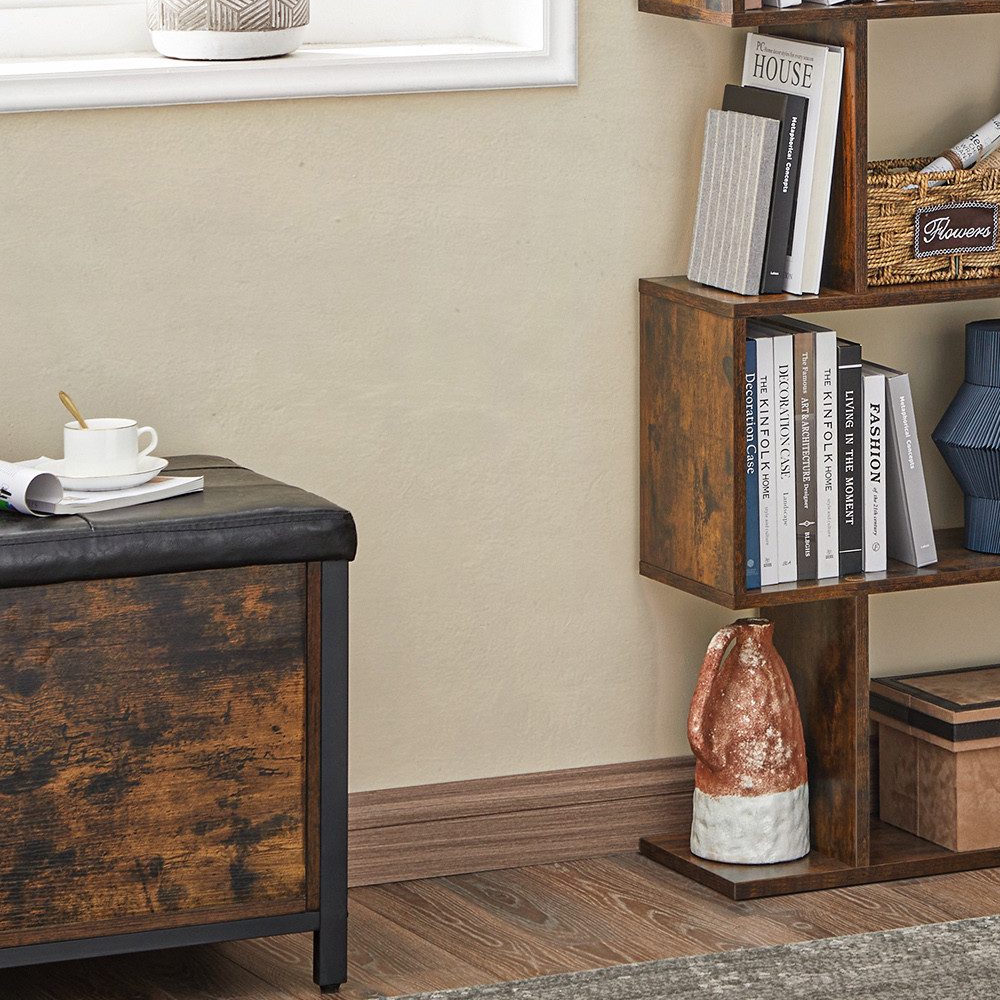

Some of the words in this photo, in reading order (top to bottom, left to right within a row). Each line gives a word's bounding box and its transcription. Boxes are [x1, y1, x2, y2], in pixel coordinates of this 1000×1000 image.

[752, 54, 814, 88] HOUSE
[787, 116, 797, 160] Metaphorical
[782, 162, 791, 193] Concepts
[924, 216, 991, 243] Flowers
[745, 373, 755, 442] Decoration
[779, 365, 790, 445] DECORATION
[801, 397, 809, 414] ART
[845, 390, 855, 428] LIVING
[759, 399, 770, 471] KINFOLK
[823, 391, 833, 463] KINFOLK
[845, 433, 854, 445] IN
[870, 403, 881, 483] FASHION
[899, 395, 911, 438] Metaphorical
[906, 440, 915, 469] Concepts
[747, 444, 757, 474] Case
[780, 449, 791, 480] CASE
[801, 421, 811, 482] ARCHITECTURE
[845, 449, 854, 472] THE
[762, 474, 770, 499] HOME
[845, 477, 854, 525] MOMENT
